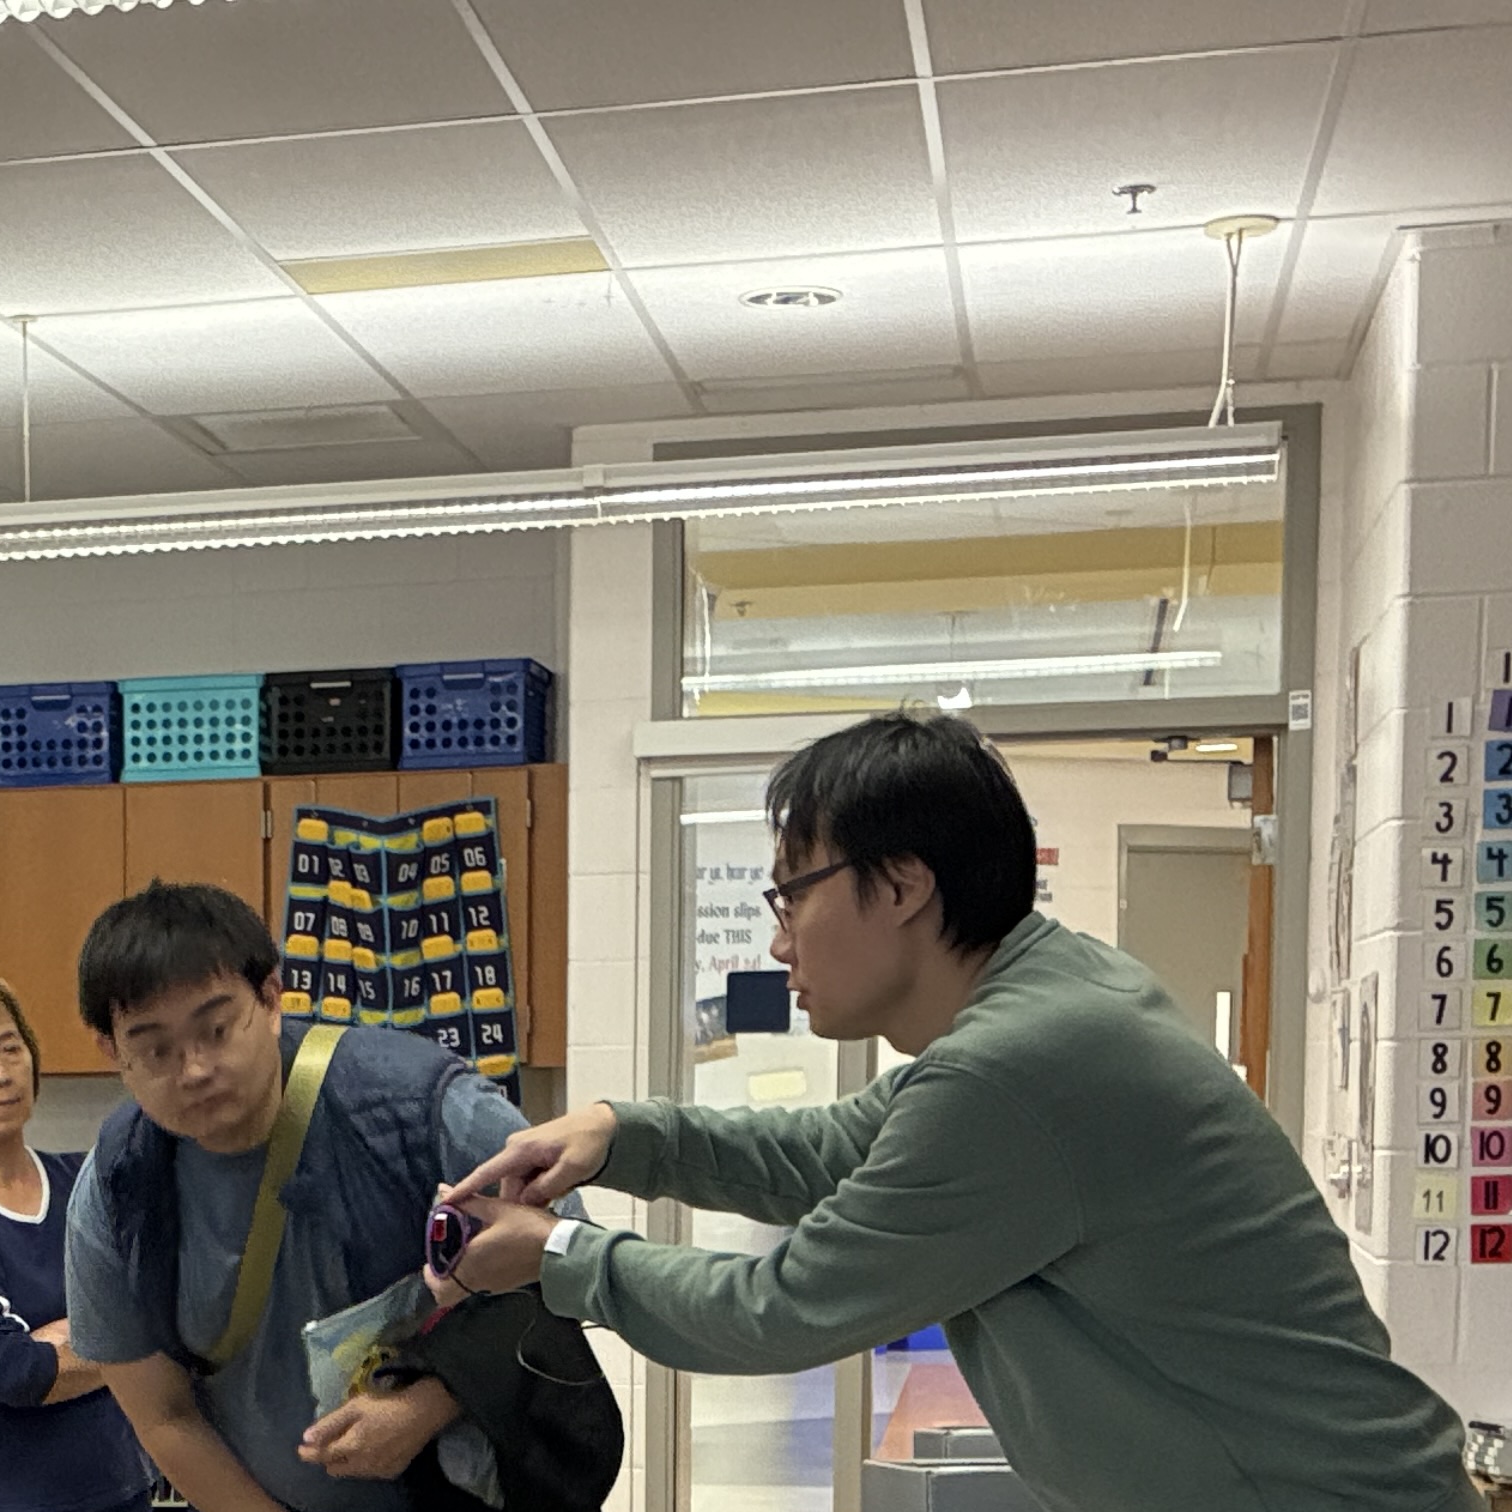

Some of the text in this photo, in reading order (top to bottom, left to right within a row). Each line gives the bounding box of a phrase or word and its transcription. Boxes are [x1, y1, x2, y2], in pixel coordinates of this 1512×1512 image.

[1446, 702, 1454, 733] 1
[1436, 751, 1458, 783] 2
[1496, 743, 1512, 776] 2
[1435, 802, 1454, 834] 3
[1495, 793, 1512, 825] 3
[297, 853, 320, 875] 01
[328, 857, 345, 878] 02
[397, 862, 419, 883] 04
[430, 852, 451, 875] 05
[463, 846, 487, 867] 06
[1430, 852, 1454, 883] 4
[1485, 847, 1509, 878] 4
[293, 911, 316, 932] 07
[401, 919, 419, 940] 10
[429, 912, 450, 934] 11
[468, 906, 491, 927] 12
[734, 902, 762, 921] slips
[1435, 899, 1454, 931] 5
[1485, 896, 1506, 928] 5
[723, 929, 753, 945] THIS
[709, 954, 740, 976] April
[1436, 946, 1454, 978] 6
[1486, 944, 1504, 974] 6
[291, 965, 497, 1000] 13 14 15 16 17 18
[1431, 994, 1448, 1025] 7
[1486, 991, 1502, 1022] 7
[437, 1023, 504, 1048] 23 24
[1431, 1043, 1448, 1075] 8
[1485, 1041, 1502, 1074] 8
[1429, 1087, 1447, 1119] 9
[1484, 1084, 1502, 1115] 9
[1423, 1133, 1452, 1165] 10
[1478, 1130, 1506, 1161] 10
[1422, 1189, 1444, 1213] 11
[1484, 1180, 1499, 1211] 11
[1423, 1229, 1451, 1261] 12
[1478, 1225, 1506, 1259] 12
